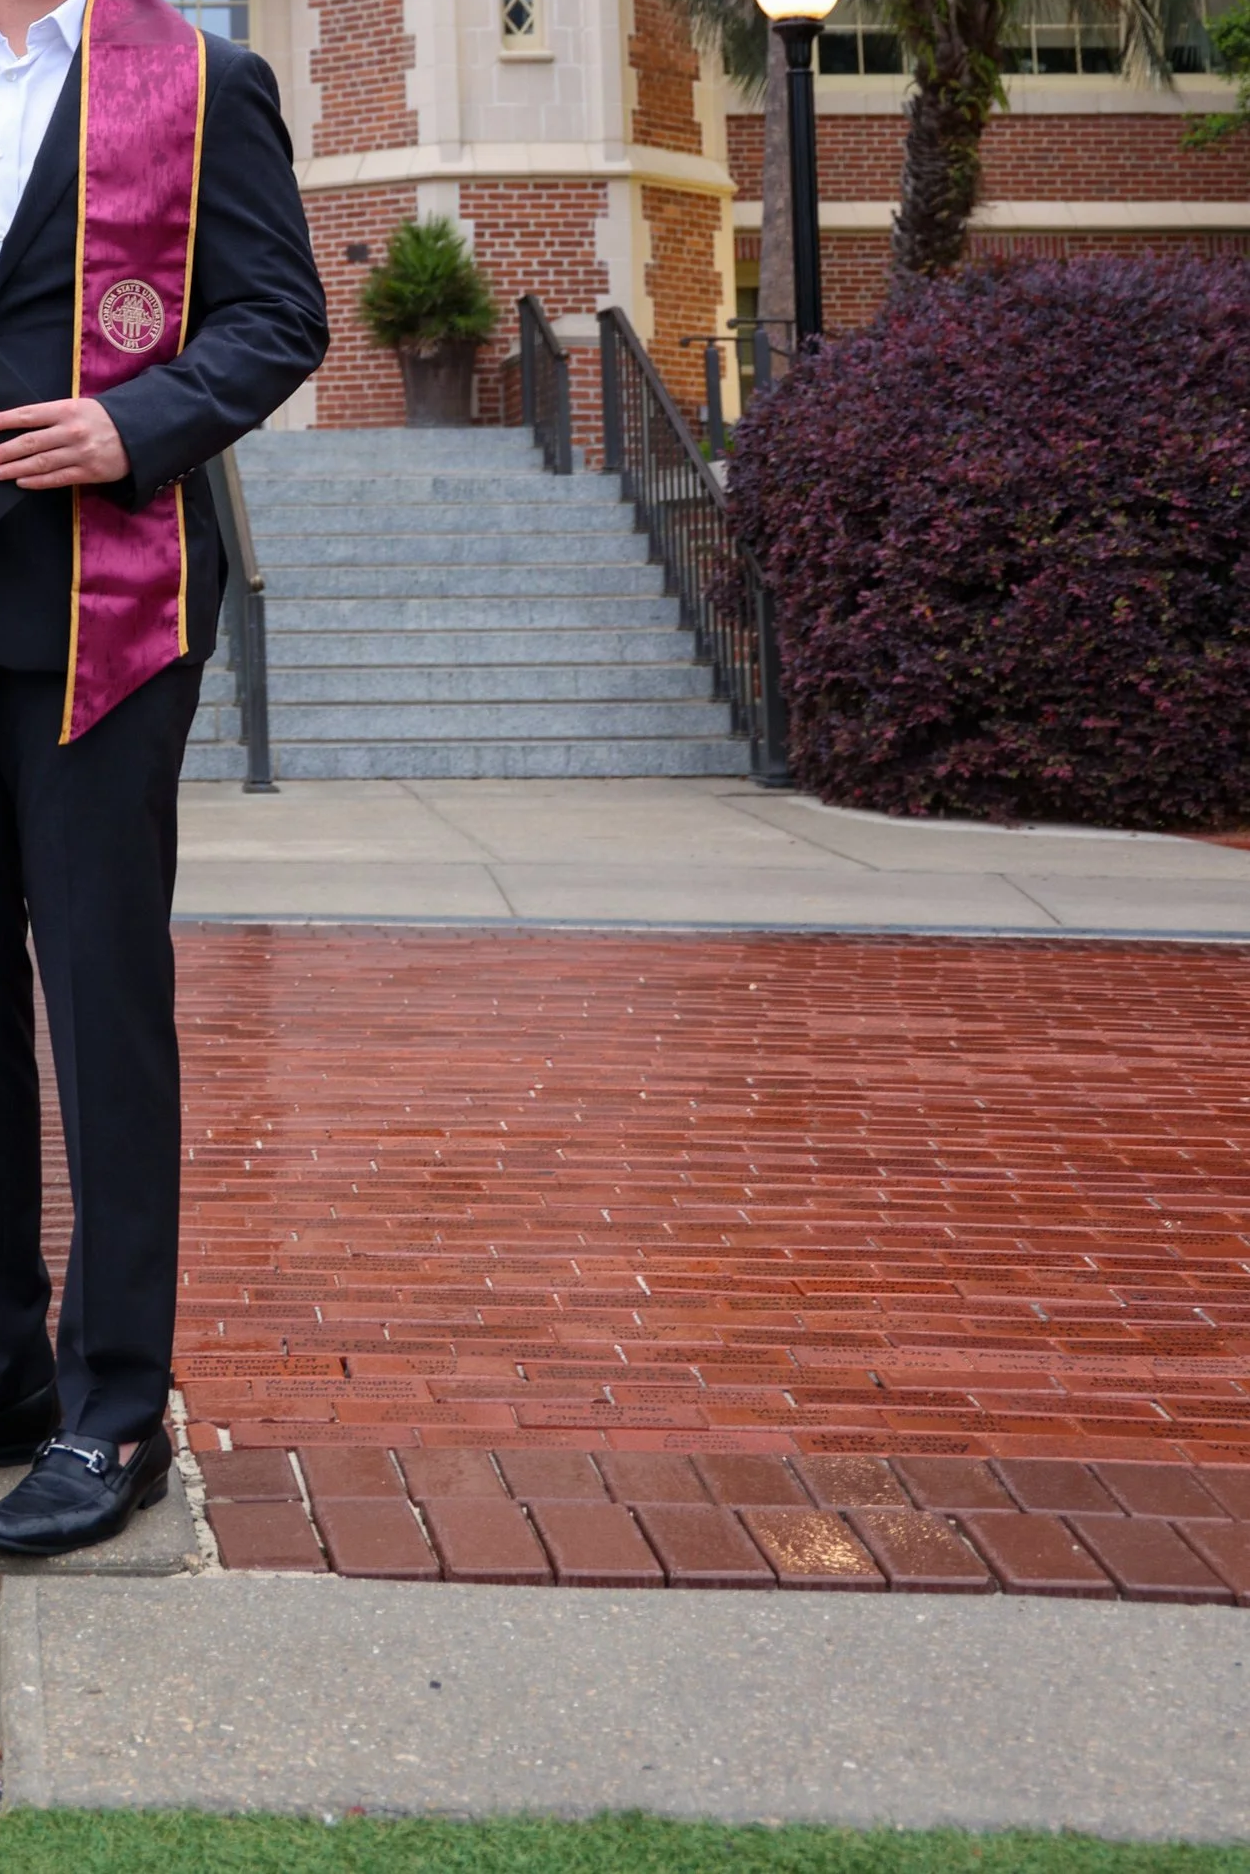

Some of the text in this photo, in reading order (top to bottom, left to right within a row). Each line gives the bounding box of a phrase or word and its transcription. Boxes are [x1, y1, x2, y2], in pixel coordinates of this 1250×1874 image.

[102, 284, 161, 339] FLORIDA STATE UNIVERSITY
[216, 1358, 291, 1366] Memory
